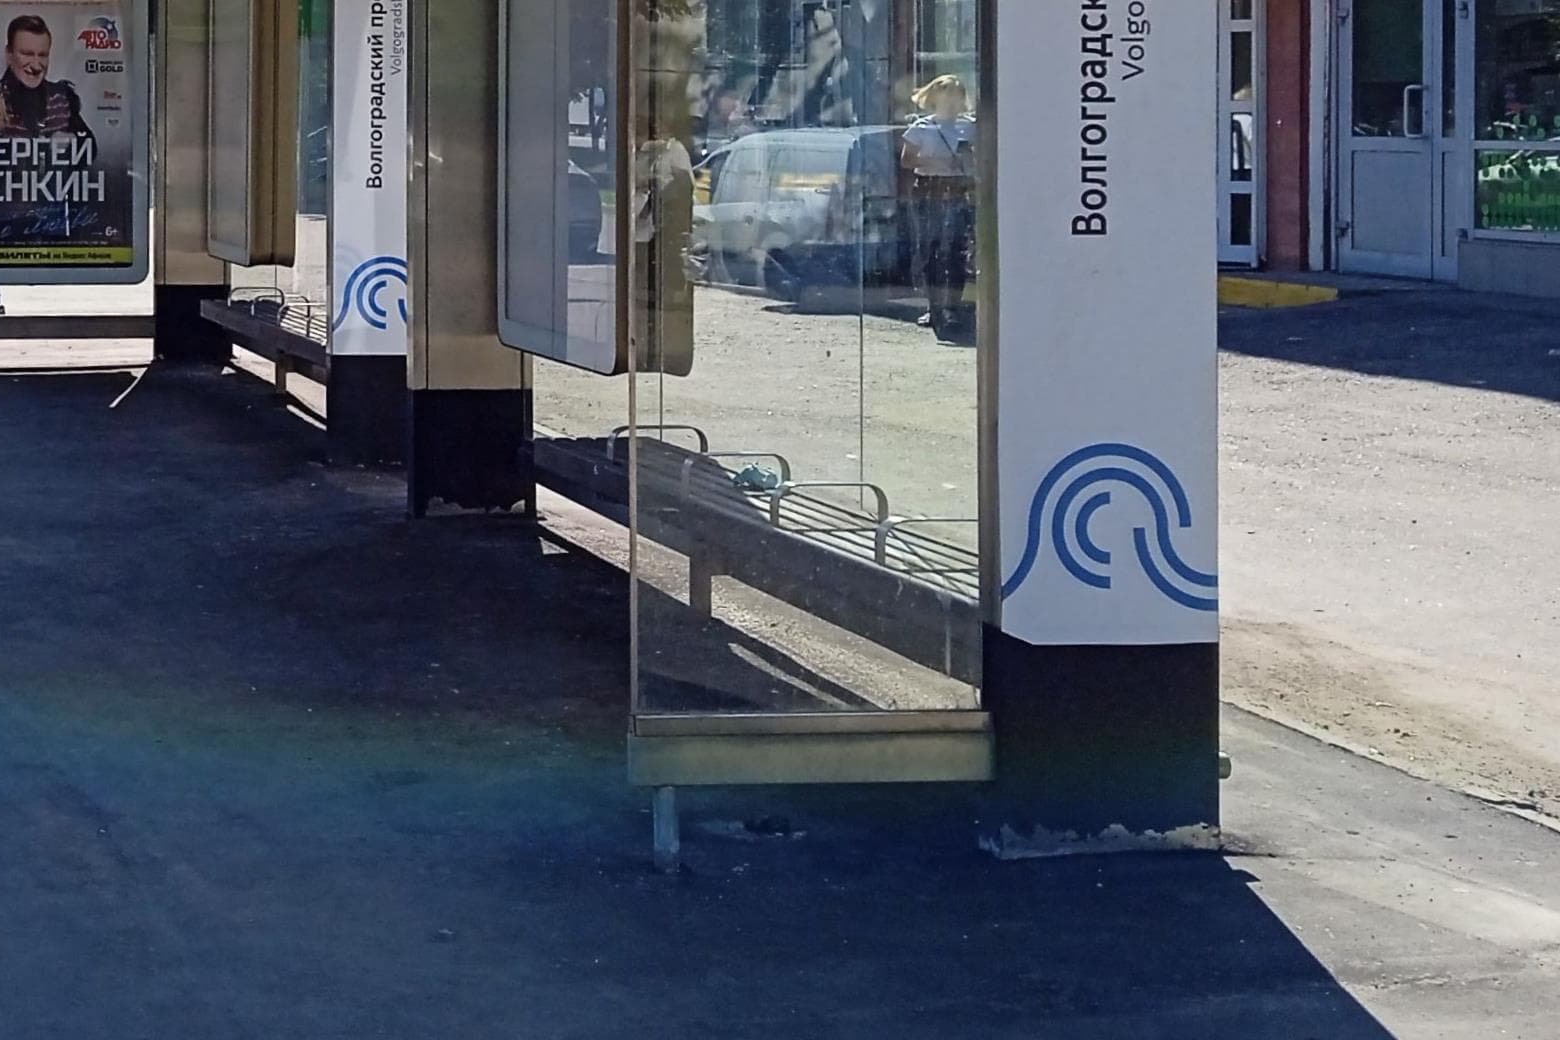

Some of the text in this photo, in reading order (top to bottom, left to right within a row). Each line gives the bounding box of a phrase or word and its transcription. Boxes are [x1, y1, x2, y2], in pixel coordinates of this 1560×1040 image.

[85, 40, 122, 49] РАДИО
[100, 65, 124, 73] GOLD
[366, 34, 386, 189] Волгоградский
[105, 226, 118, 236] 6+
